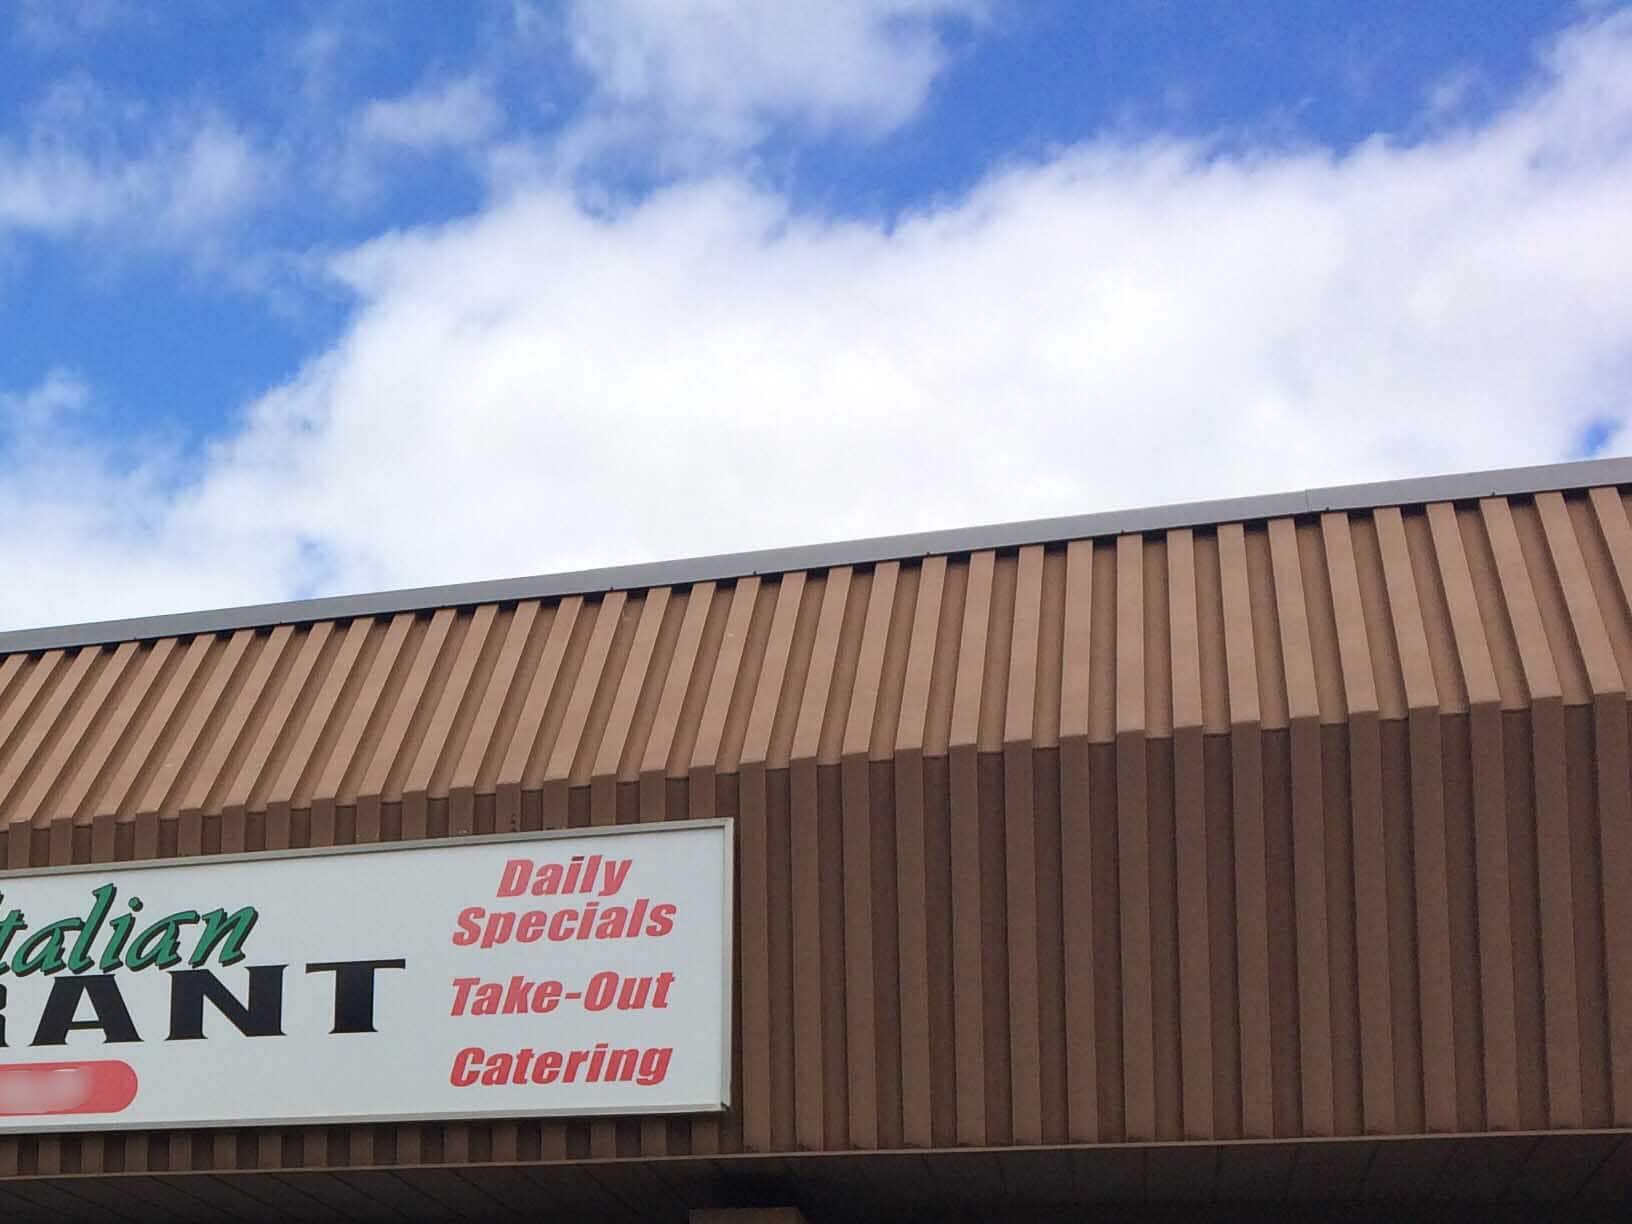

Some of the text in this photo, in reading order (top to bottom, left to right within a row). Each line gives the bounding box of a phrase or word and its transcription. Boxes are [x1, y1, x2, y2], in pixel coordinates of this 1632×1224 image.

[496, 854, 632, 898] Daily
[452, 898, 677, 948] Specials
[450, 971, 675, 1017] Take-Out
[449, 1043, 673, 1087] Catering
